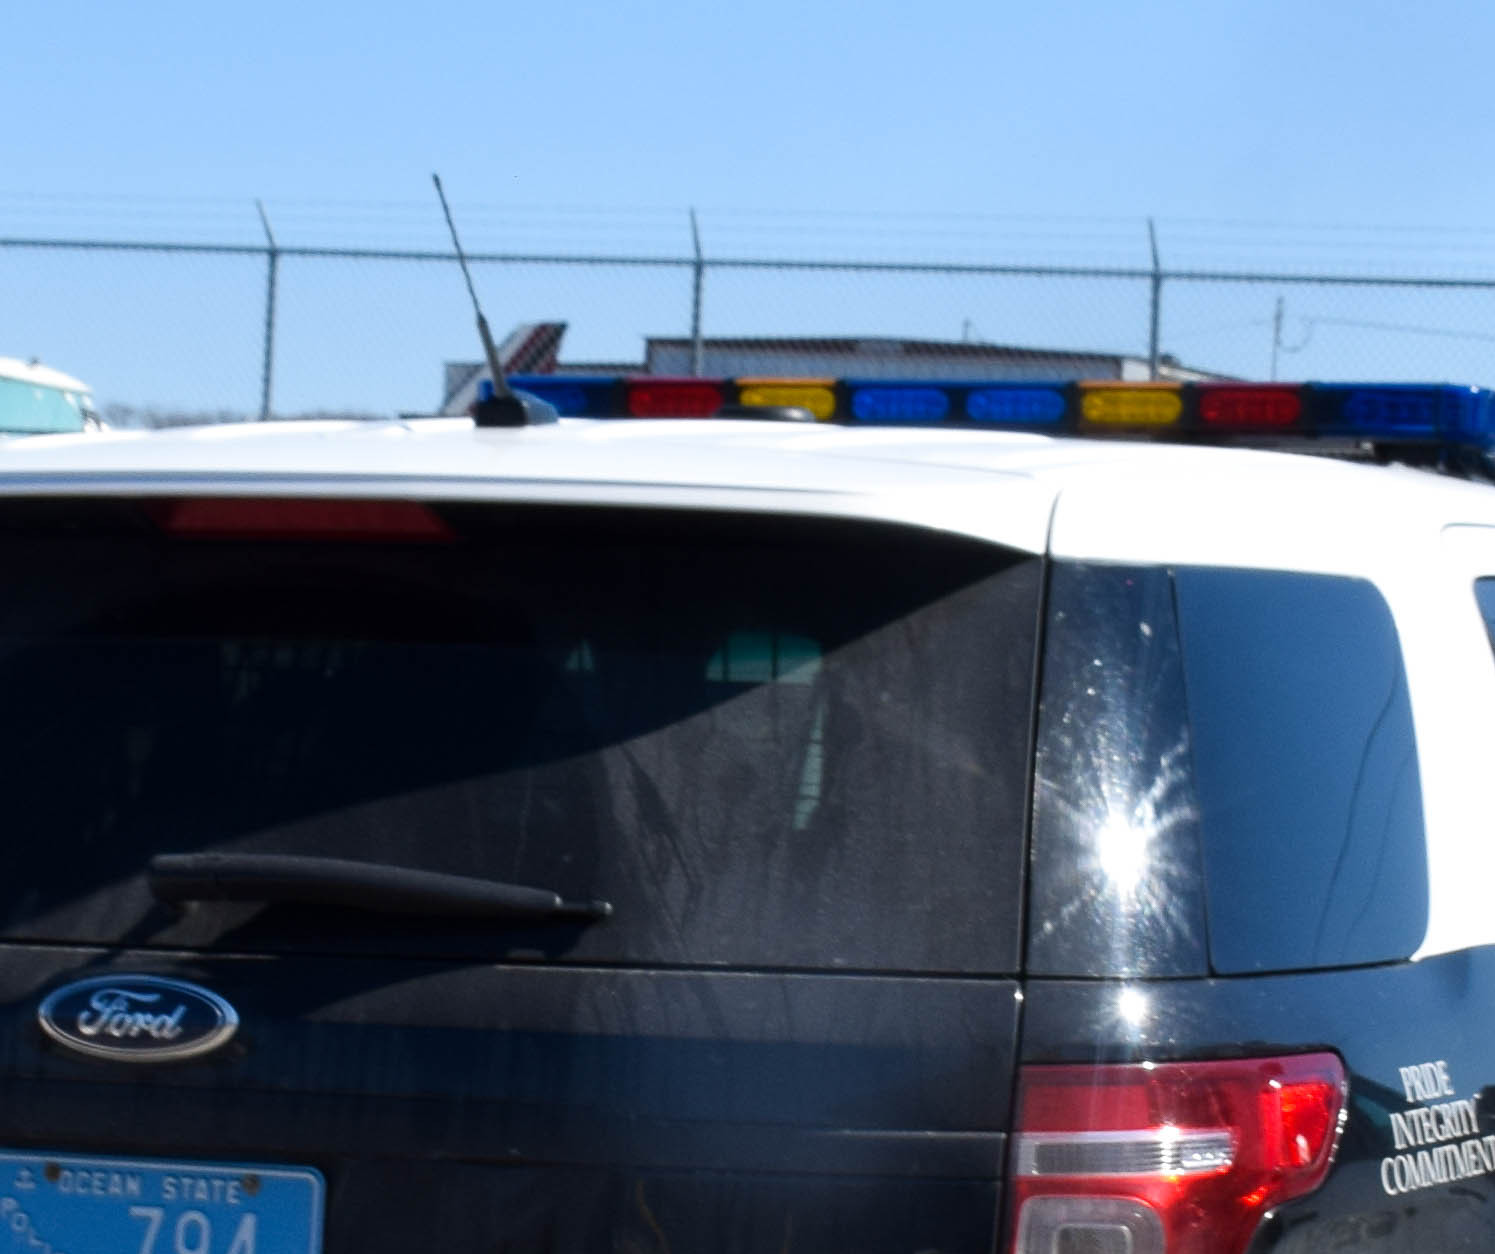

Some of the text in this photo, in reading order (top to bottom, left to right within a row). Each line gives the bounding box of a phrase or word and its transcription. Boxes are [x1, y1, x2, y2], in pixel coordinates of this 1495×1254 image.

[78, 988, 192, 1038] Ford
[1398, 1060, 1455, 1103] PRIDE
[1389, 1093, 1482, 1150] INTEGRITY
[56, 1170, 241, 1205] OCEAN STATE
